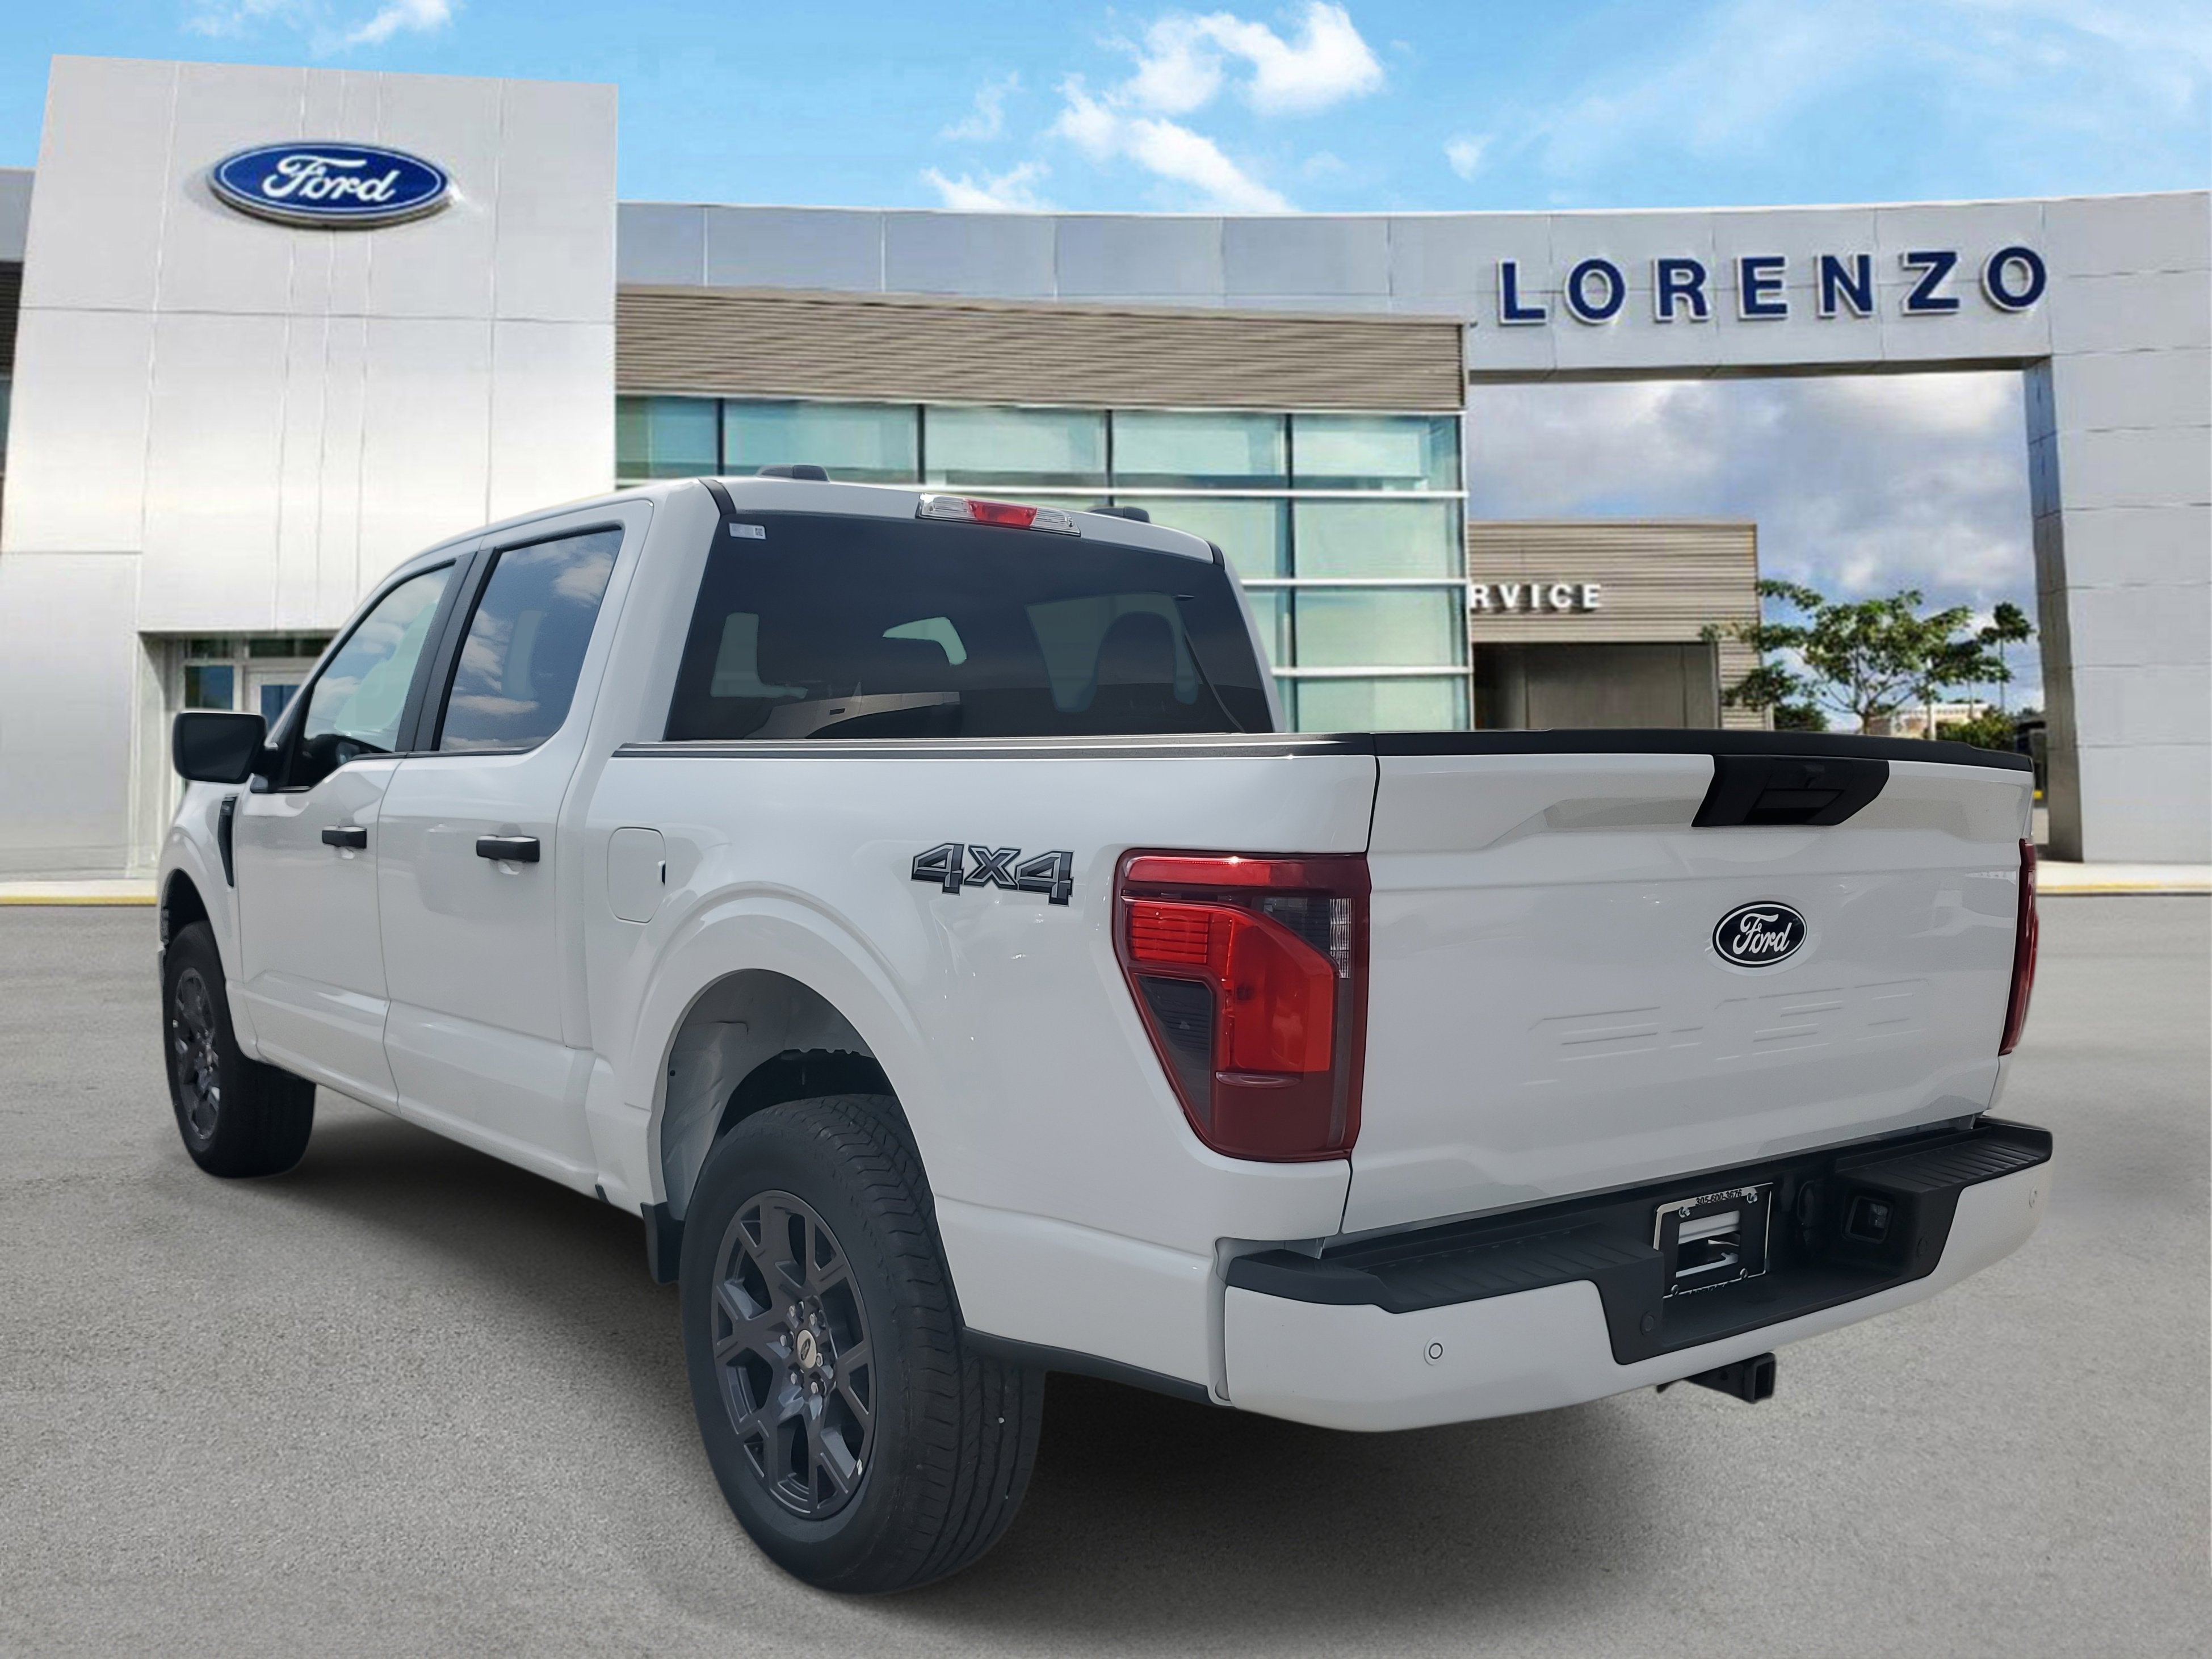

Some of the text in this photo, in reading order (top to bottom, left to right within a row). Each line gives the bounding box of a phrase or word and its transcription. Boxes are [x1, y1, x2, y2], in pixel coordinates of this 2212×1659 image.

[262, 155, 400, 202] Ford
[1499, 246, 2047, 325] LORENZO
[1470, 584, 1602, 608] RVICE
[1732, 913, 1793, 955] Ford
